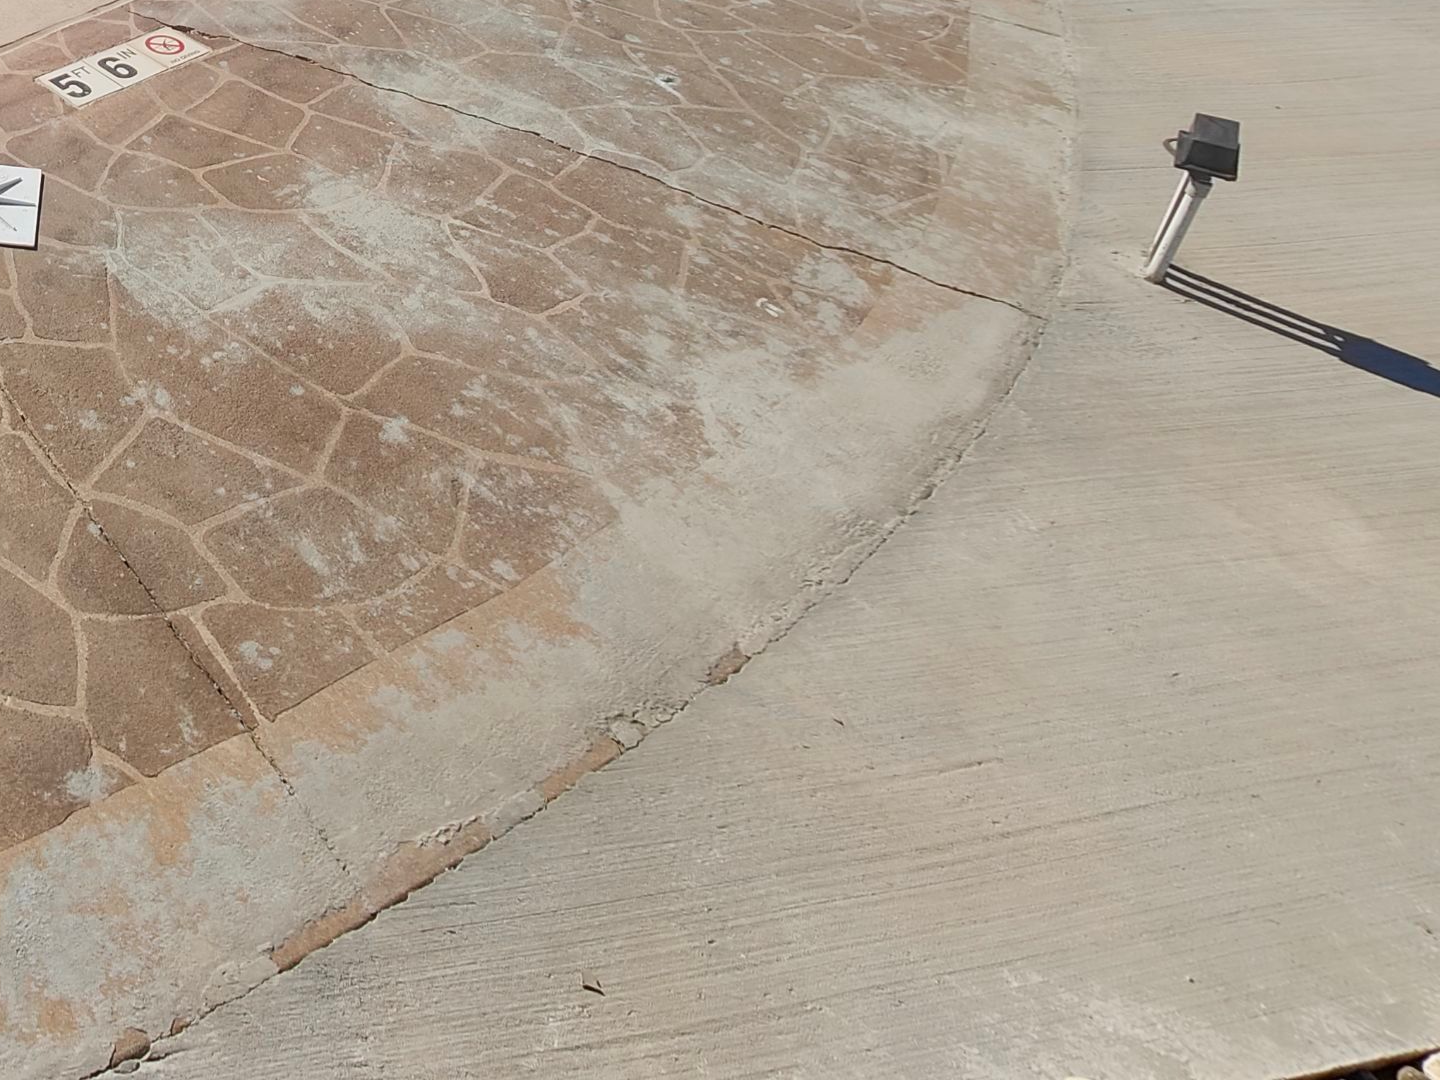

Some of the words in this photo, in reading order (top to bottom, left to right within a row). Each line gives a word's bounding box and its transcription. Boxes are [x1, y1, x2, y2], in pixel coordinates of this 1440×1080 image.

[116, 48, 137, 60] IN
[71, 66, 91, 78] FT
[97, 57, 138, 79] 6
[48, 73, 92, 98] 5
